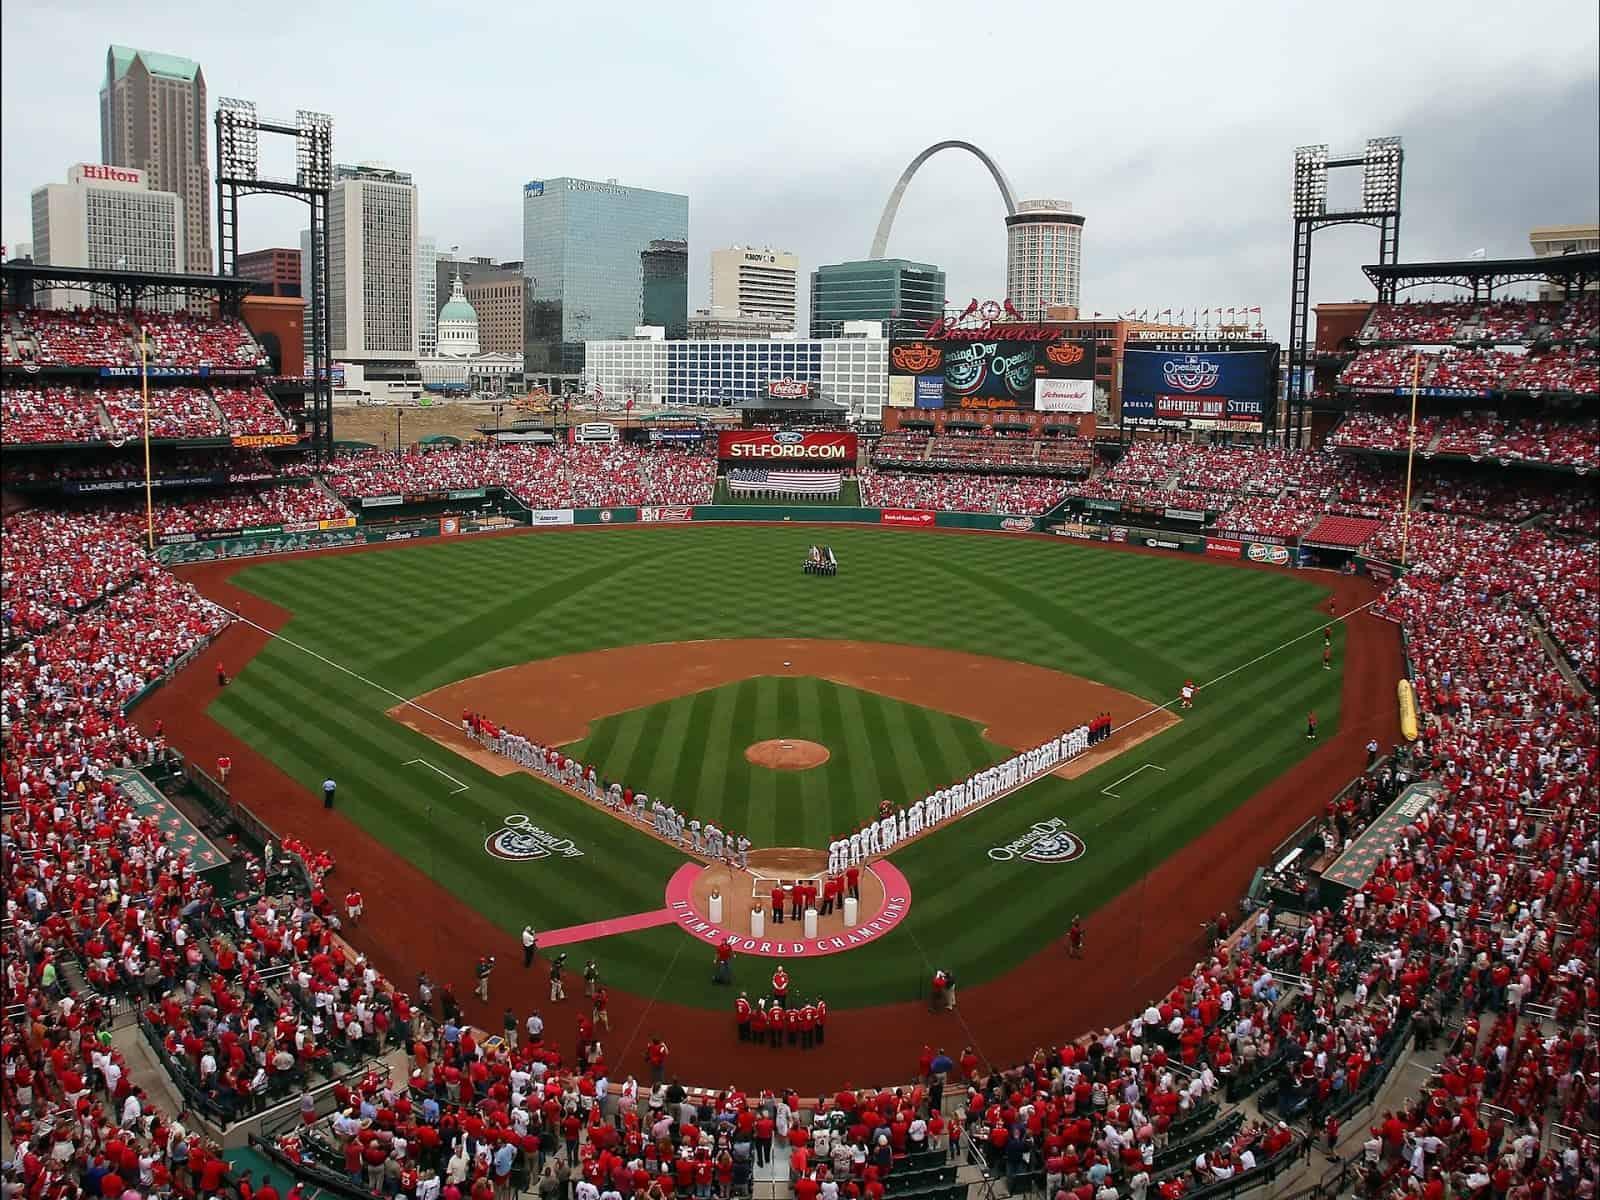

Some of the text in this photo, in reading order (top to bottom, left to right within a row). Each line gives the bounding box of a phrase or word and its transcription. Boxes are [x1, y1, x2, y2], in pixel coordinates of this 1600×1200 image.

[83, 165, 139, 183] Hilton
[916, 317, 1065, 341] Budweiser
[1139, 330, 1252, 341] WORLD CHAMPIONS
[970, 342, 998, 360] Day
[1156, 344, 1208, 352] WELCOME
[1163, 360, 1220, 374] Opening Day
[1226, 399, 1263, 414] STIFEL
[730, 443, 846, 458] STLFORD.COM
[679, 910, 721, 939] TIME
[726, 934, 804, 953] WORLD
[817, 896, 906, 951] CHAMPIONS
